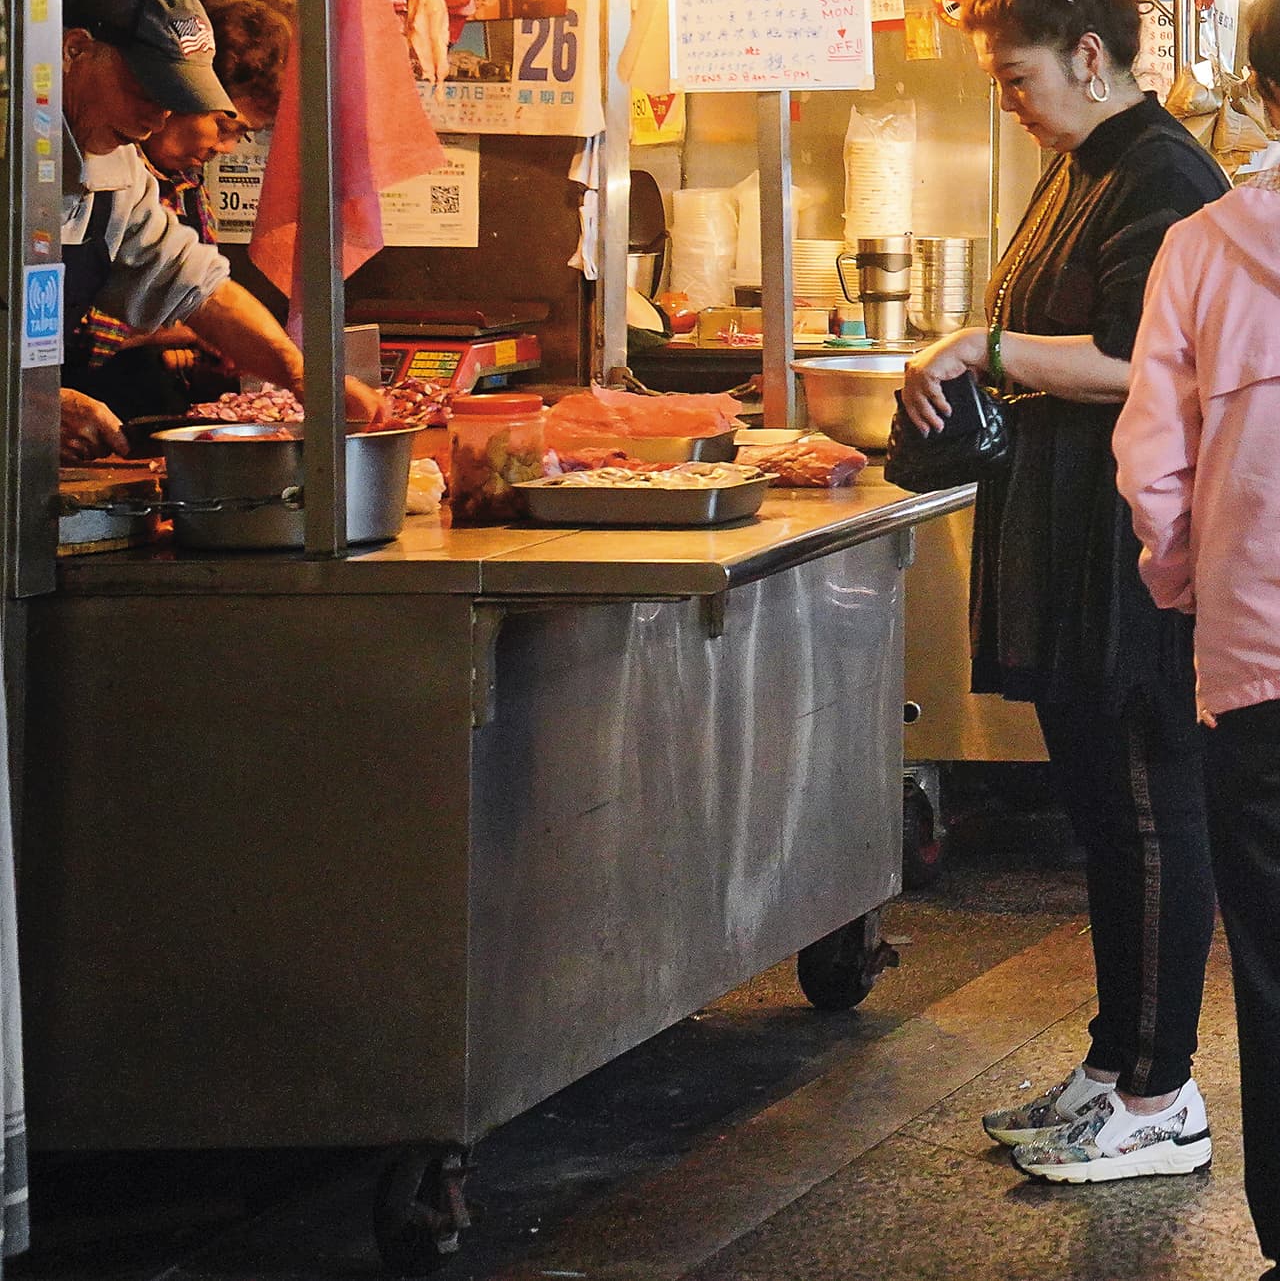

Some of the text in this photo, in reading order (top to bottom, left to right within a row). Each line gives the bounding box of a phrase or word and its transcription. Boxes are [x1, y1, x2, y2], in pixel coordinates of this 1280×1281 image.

[516, 9, 579, 83] 26
[516, 89, 575, 106] 星期四
[218, 191, 241, 211] 30
